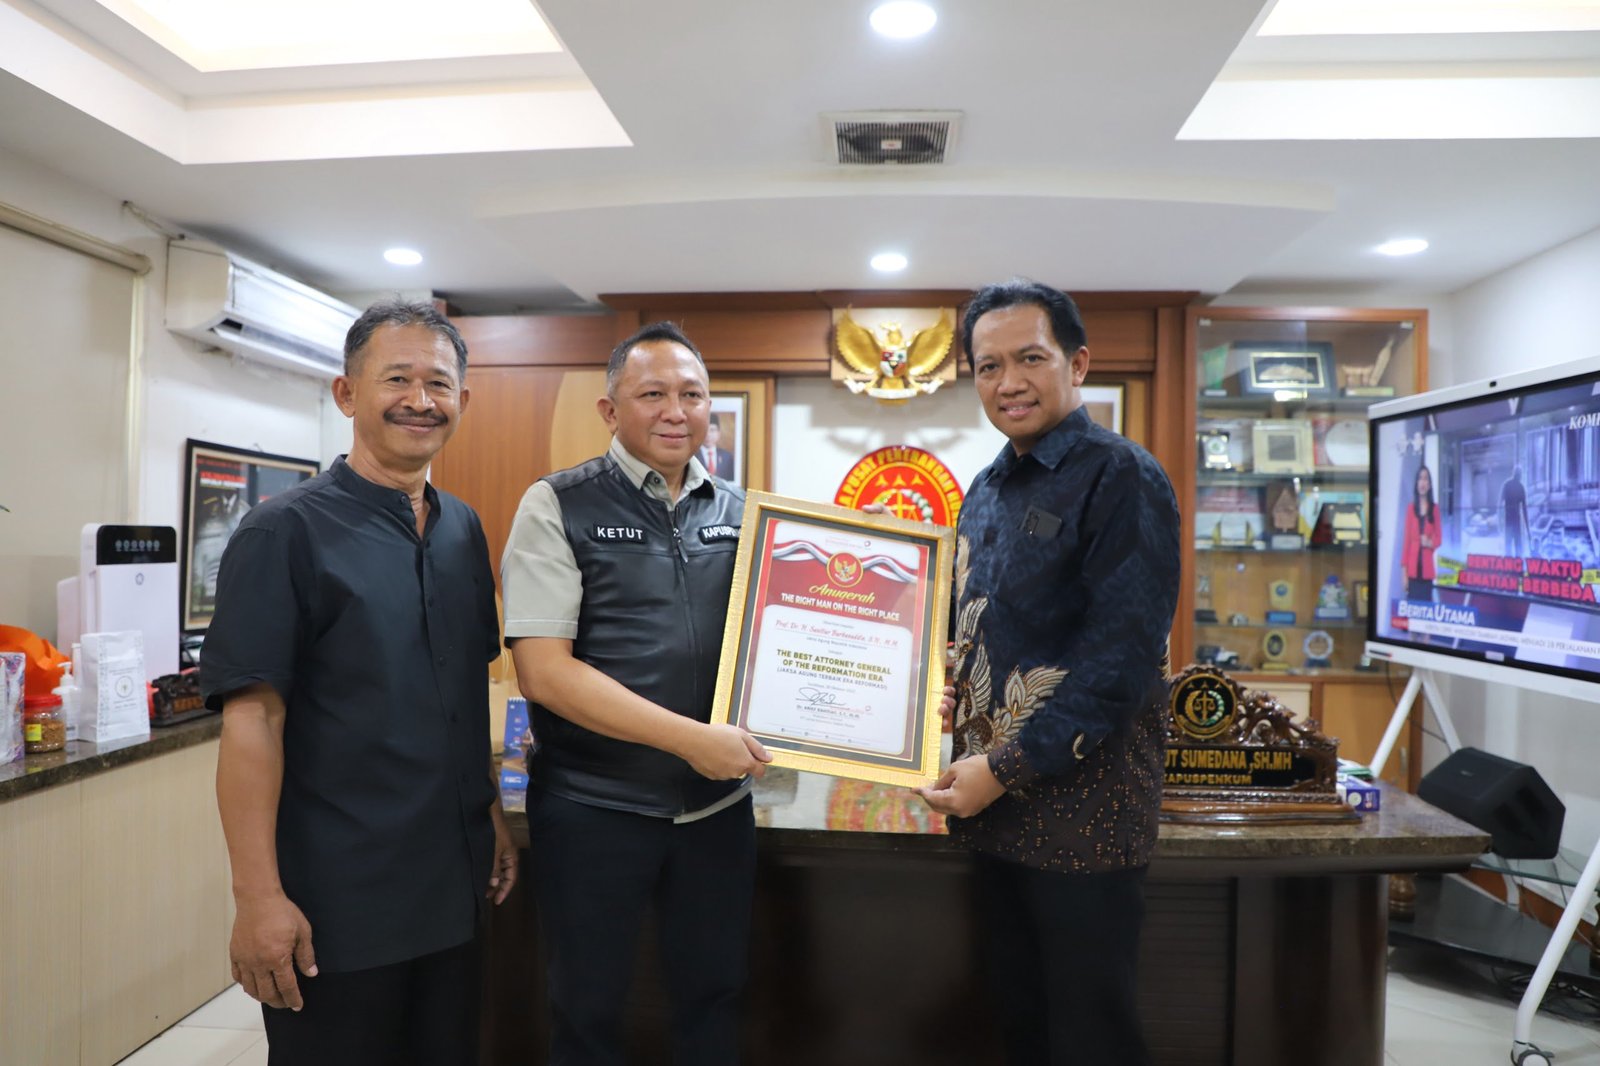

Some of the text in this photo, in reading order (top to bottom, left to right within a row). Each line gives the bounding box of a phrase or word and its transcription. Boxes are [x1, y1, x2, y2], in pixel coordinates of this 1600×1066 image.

[597, 526, 643, 540] KETUT
[702, 525, 739, 539] KAPUSP
[1525, 558, 1582, 579] WAKTU
[808, 583, 876, 604] Anugerah
[1522, 576, 1595, 603] BERBEDA
[781, 592, 900, 622] THE RIGHT MAN ON THE RIGHT PLACE
[776, 648, 892, 675] THE BEST ATTORNEY GENERAL
[782, 658, 884, 682] OF THE REFORMATION ERA
[798, 670, 818, 679] AGUNG
[1181, 749, 1247, 769] SUMEDANA
